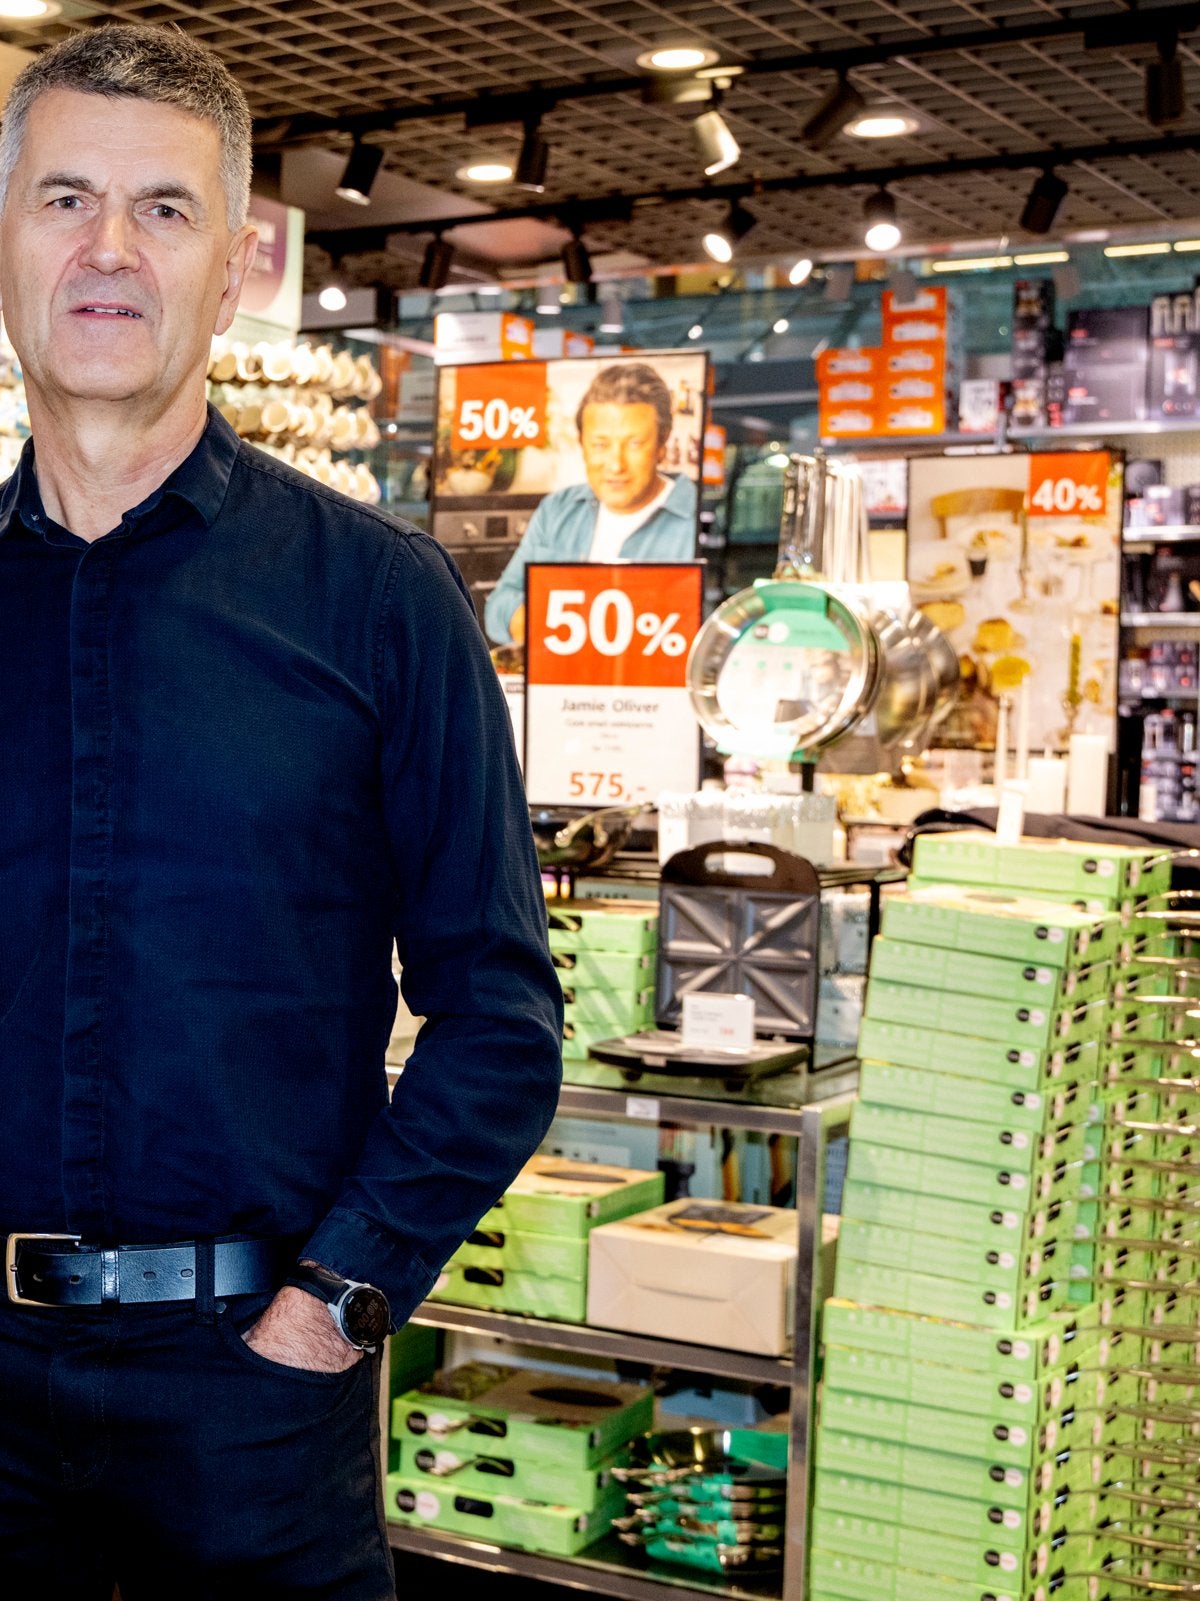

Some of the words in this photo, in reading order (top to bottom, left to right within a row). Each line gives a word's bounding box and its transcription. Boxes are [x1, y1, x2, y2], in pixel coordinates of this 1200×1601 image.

[459, 398, 539, 441] 50%
[1031, 477, 1103, 512] 40%
[543, 588, 687, 656] 50%
[562, 699, 605, 711] Jamie
[612, 699, 659, 712] Oliver
[569, 771, 646, 802] 575,-
